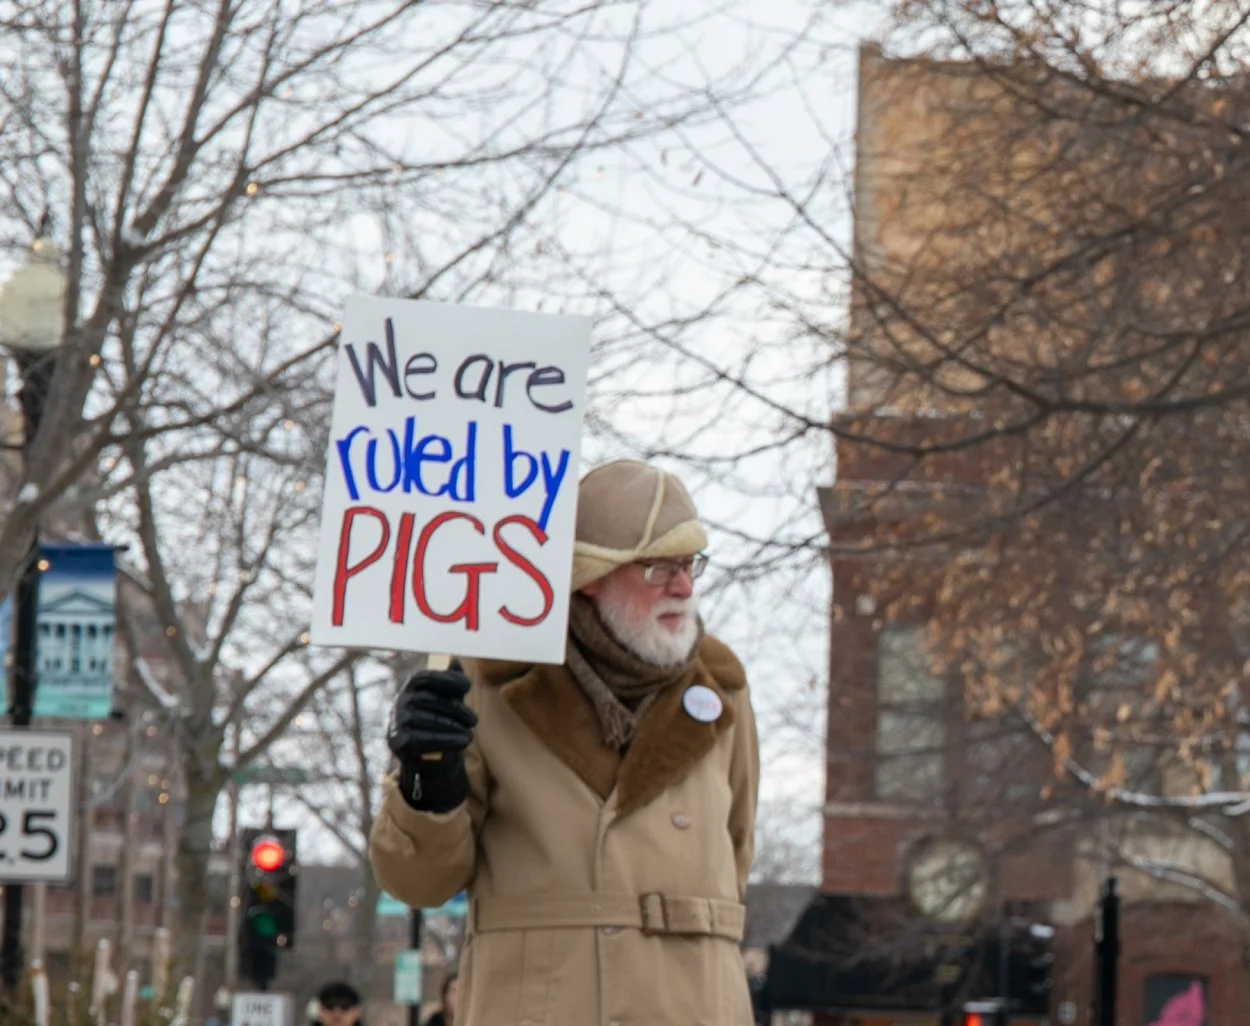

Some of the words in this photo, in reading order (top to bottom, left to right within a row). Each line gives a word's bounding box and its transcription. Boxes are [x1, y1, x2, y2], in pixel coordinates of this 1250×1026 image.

[344, 317, 438, 407] We
[453, 354, 574, 413] are
[336, 416, 477, 503] ruled
[503, 423, 570, 532] by
[332, 505, 554, 632] PIGS
[0, 745, 66, 772] EED
[0, 808, 60, 862] 5
